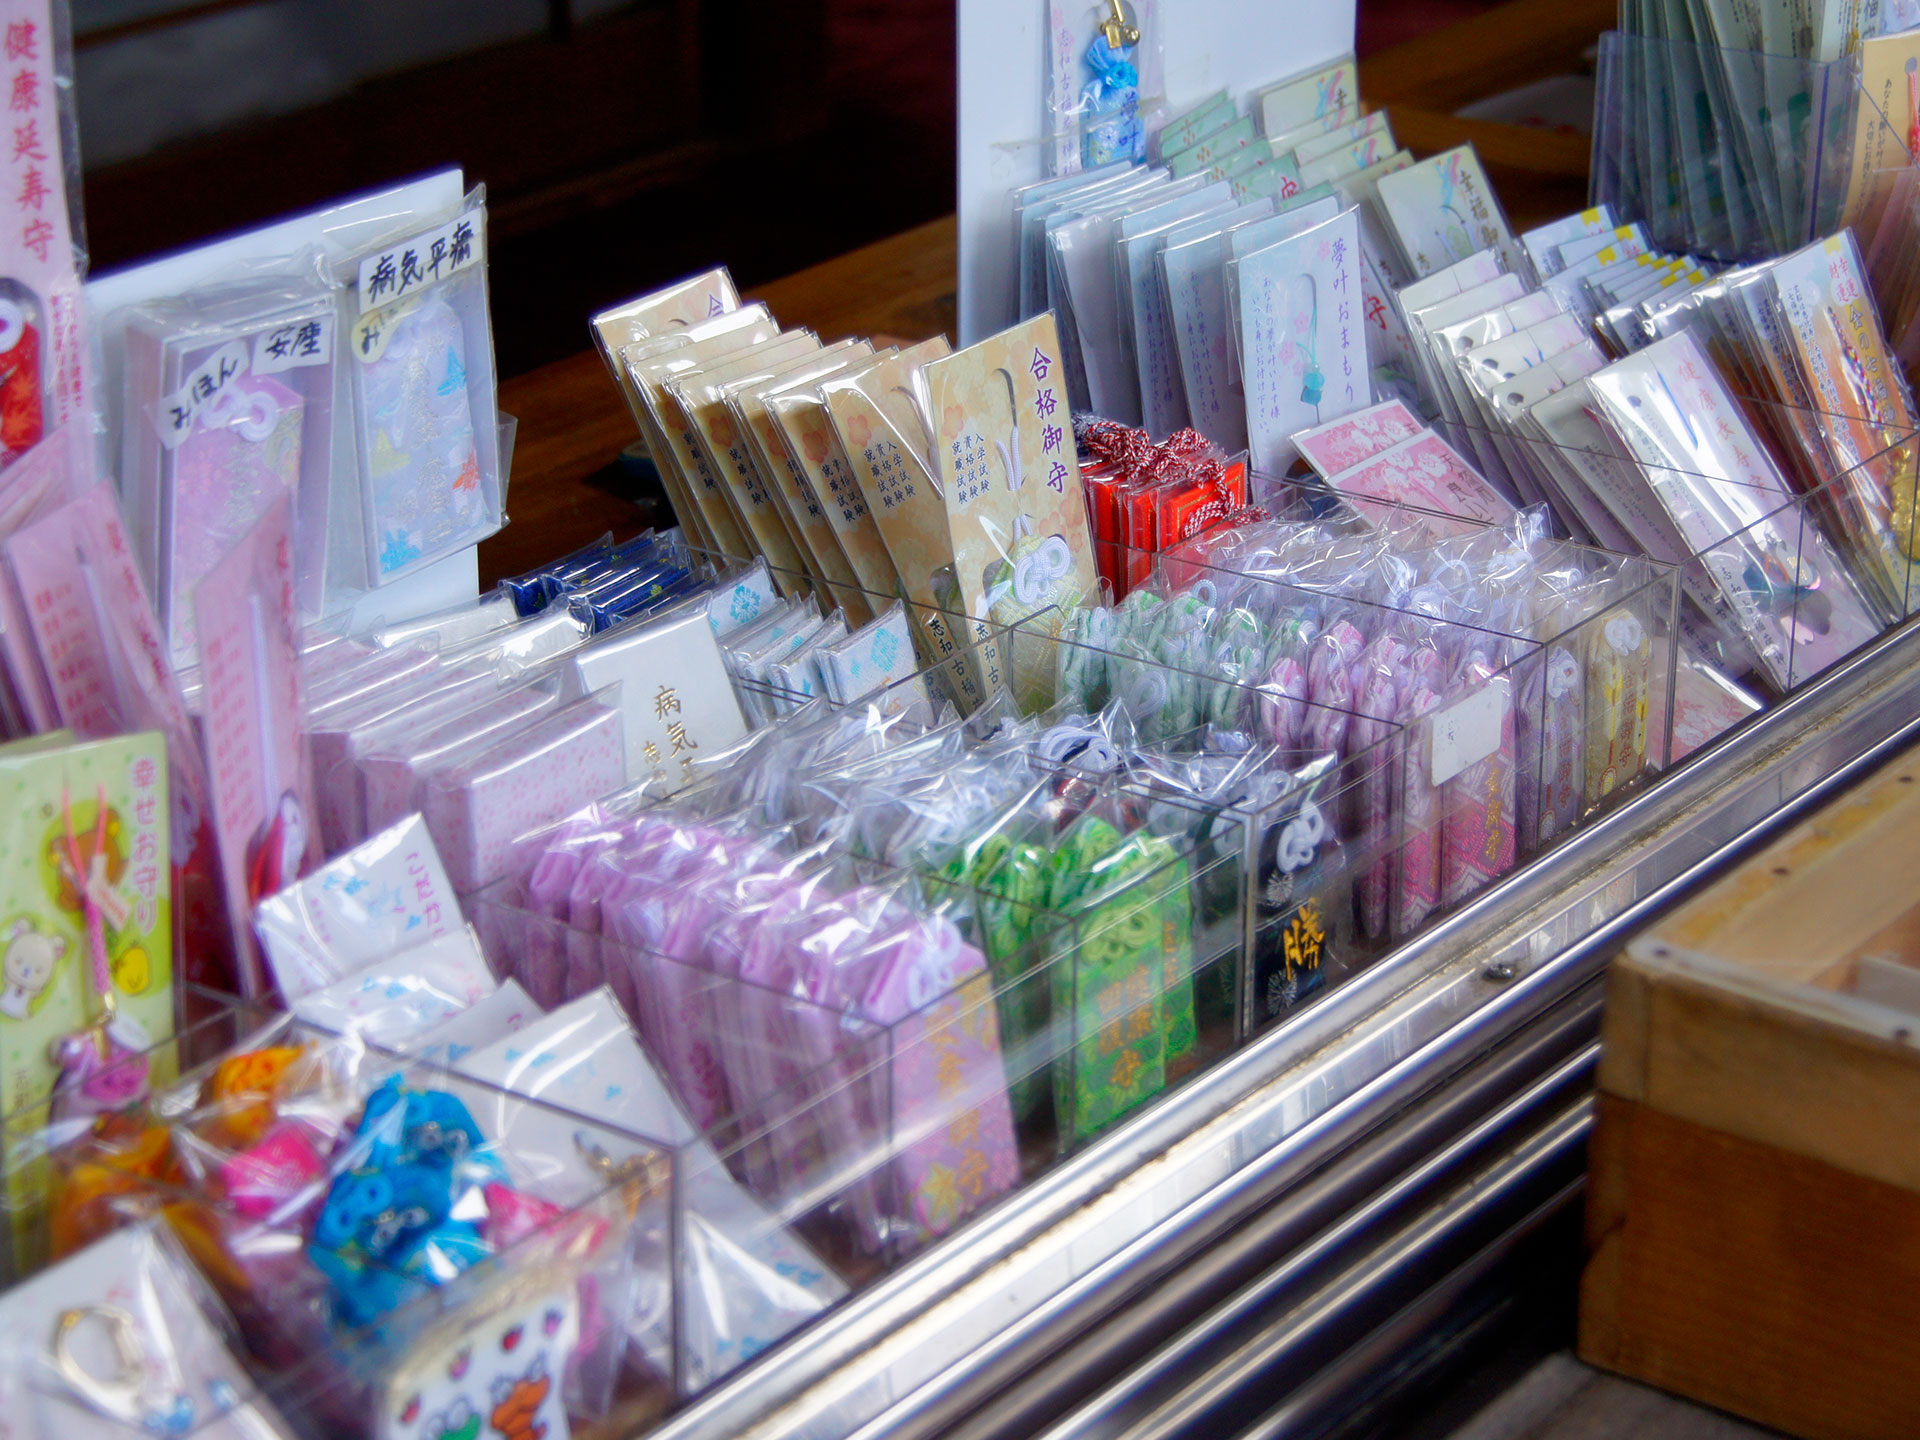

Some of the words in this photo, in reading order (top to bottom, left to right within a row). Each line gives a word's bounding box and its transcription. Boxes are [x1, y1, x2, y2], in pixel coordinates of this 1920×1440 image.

[4, 17, 54, 263] 健康延寿守
[1331, 236, 1355, 403] 夢叶おまもり
[169, 355, 239, 431] みほん
[1029, 347, 1069, 494] 合格御守
[863, 447, 895, 509] 就職試験
[951, 440, 969, 505] 就職試験
[963, 434, 979, 500] 資格試験
[975, 432, 991, 494] 入学試験
[975, 621, 1003, 695] 志和古
[132, 756, 160, 937] 幸せお守り
